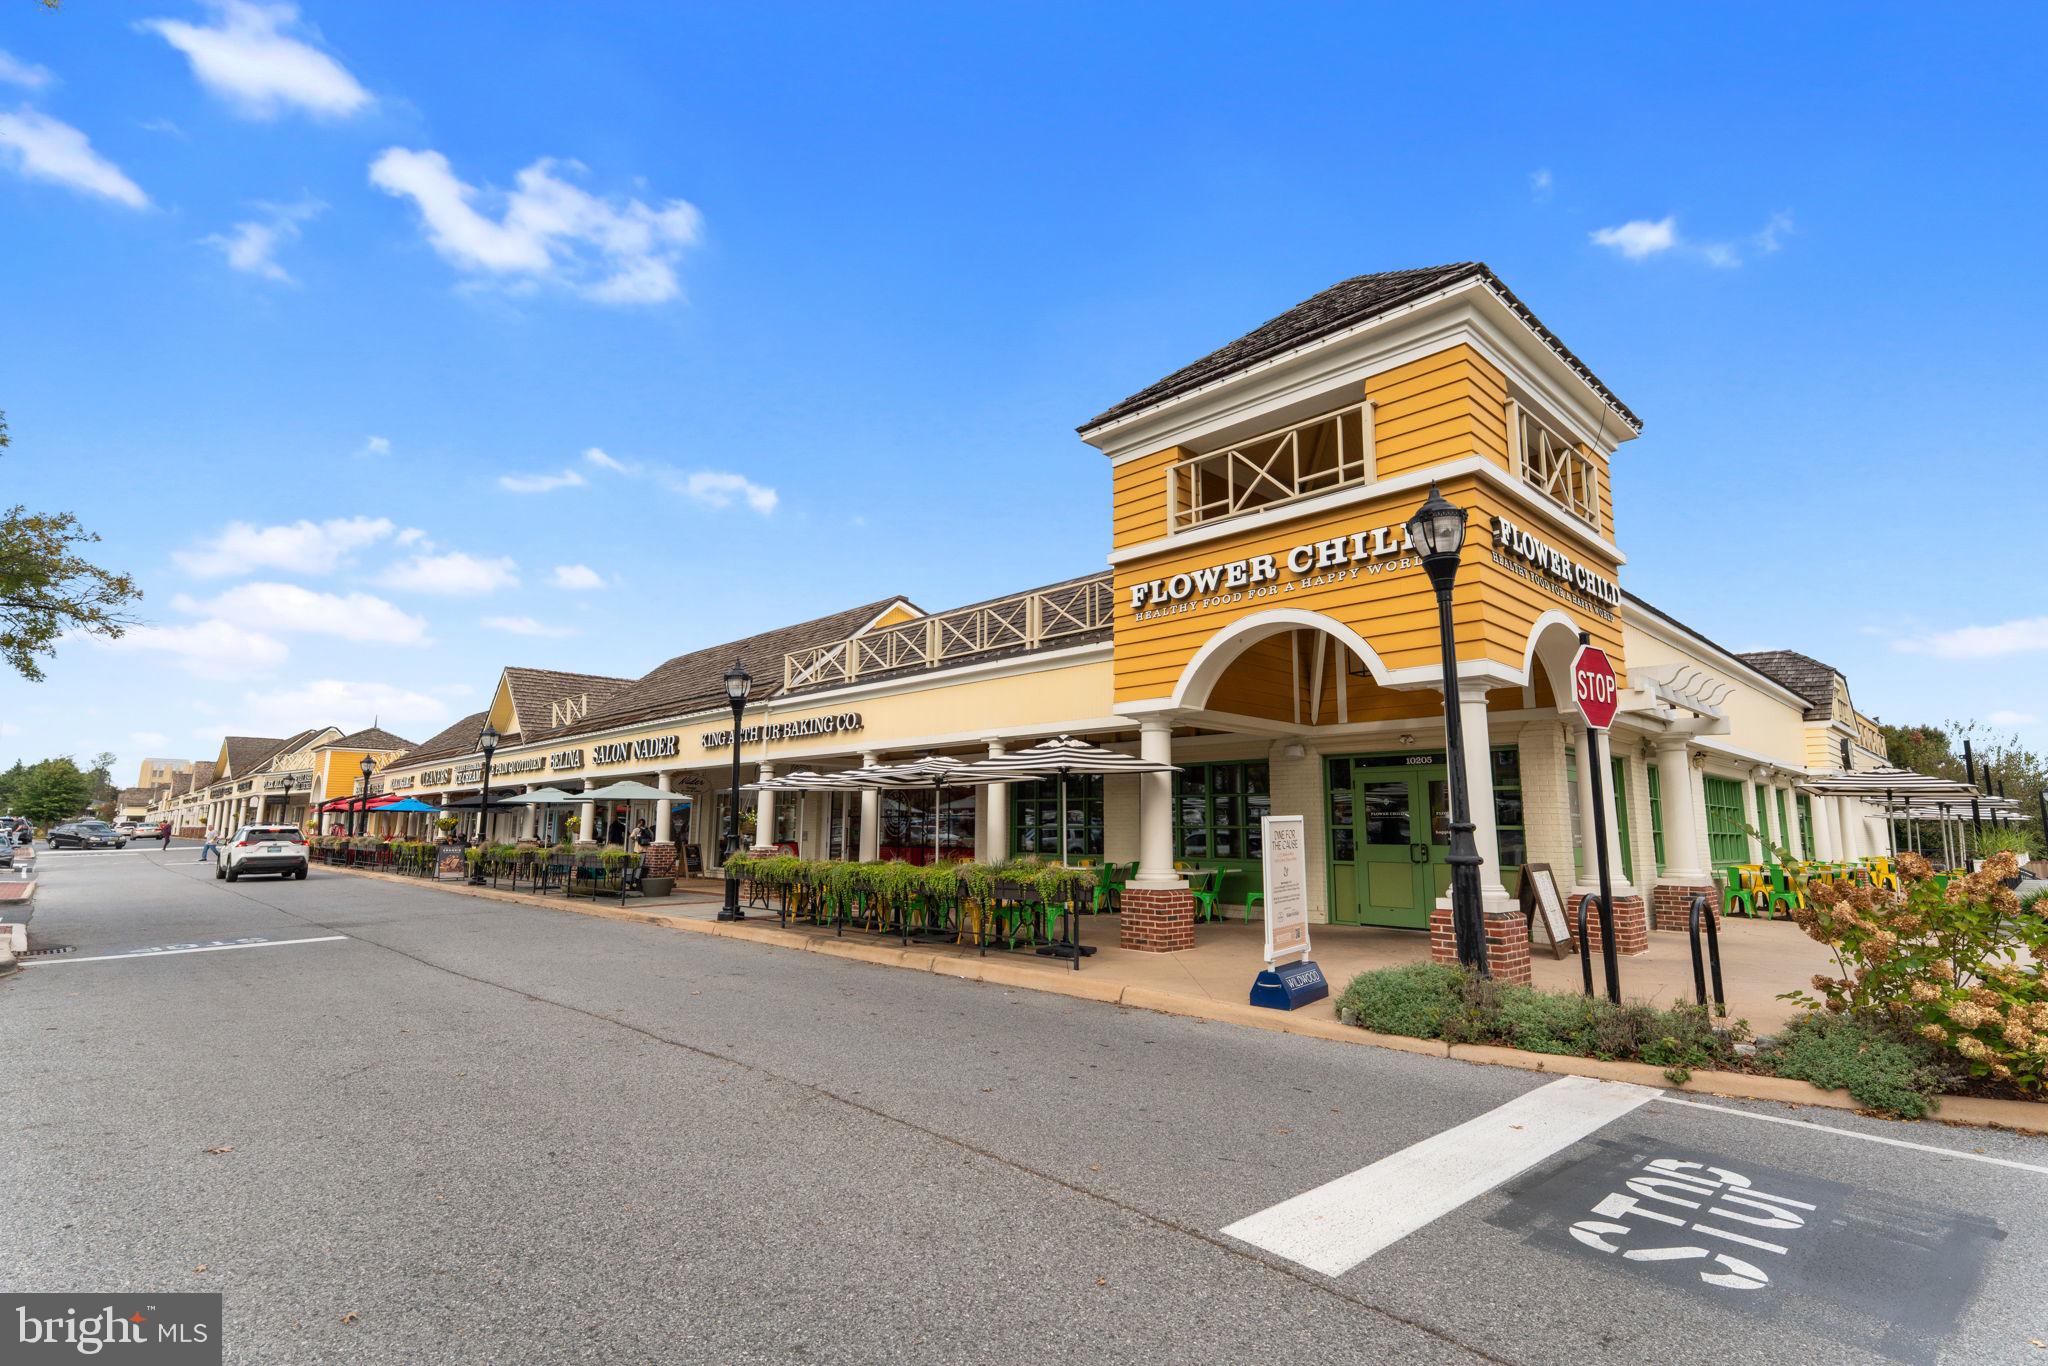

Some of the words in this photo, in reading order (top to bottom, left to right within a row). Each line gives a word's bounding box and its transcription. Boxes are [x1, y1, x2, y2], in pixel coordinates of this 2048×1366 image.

[1498, 516, 1573, 583] FLOWER
[1575, 564, 1621, 608] CHILD
[1129, 554, 1277, 608] FLOWER
[1136, 600, 1198, 622] HEALTHY
[1203, 592, 1242, 608] FOOD
[1248, 586, 1278, 600] FOR
[1284, 581, 1295, 592] A
[1301, 568, 1361, 588] HAPPY
[1367, 555, 1423, 576] WORL
[1491, 551, 1529, 580] HEALTHY
[1529, 572, 1551, 591] FOOD
[1551, 583, 1566, 600] FOR
[1572, 594, 1594, 613] HAPPY
[1593, 605, 1615, 623] WORLD
[1578, 670, 1615, 703] STOP
[701, 731, 726, 748] KING
[783, 715, 834, 738] BAKING
[836, 712, 860, 731] CO.
[550, 750, 581, 769] BELINA
[592, 742, 628, 765] SALON
[633, 735, 676, 760] NADER
[1406, 756, 1433, 765] 10205
[1286, 970, 1320, 989] WILDWOOD
[1568, 1158, 1817, 1290] STOP
